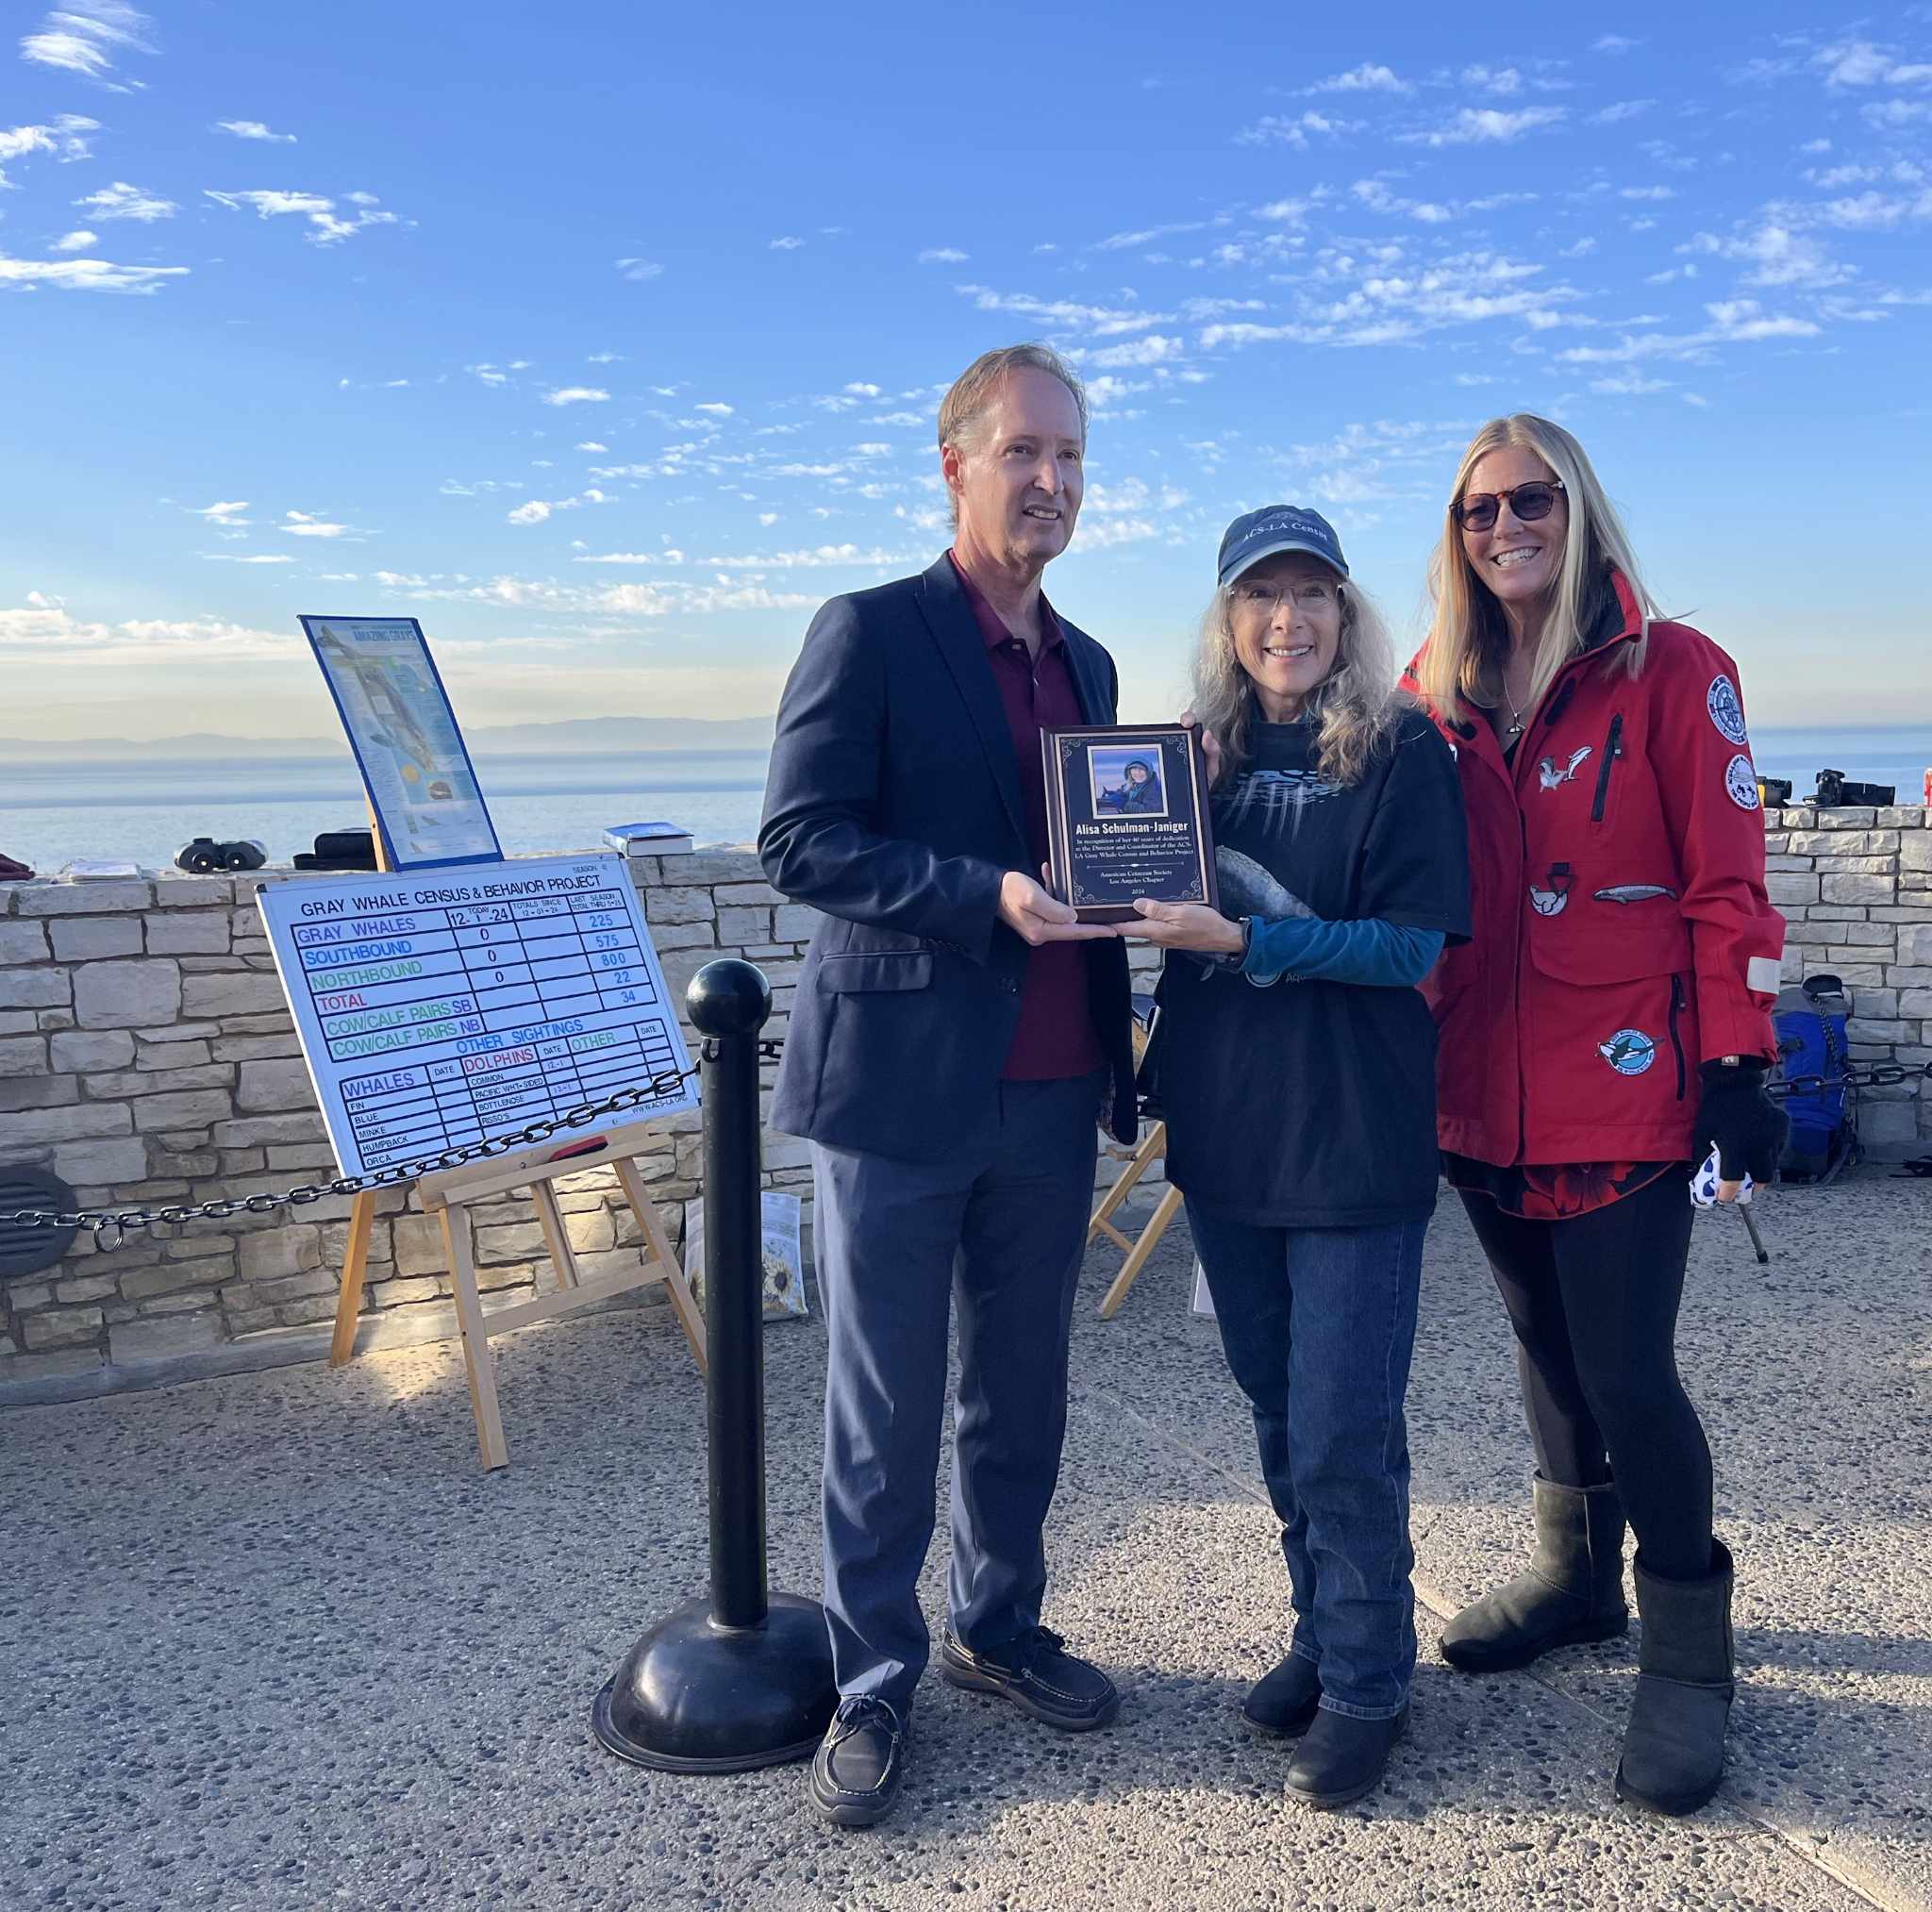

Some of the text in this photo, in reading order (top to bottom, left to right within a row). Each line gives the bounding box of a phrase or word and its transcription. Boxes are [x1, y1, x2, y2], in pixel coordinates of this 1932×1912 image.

[1241, 523, 1328, 543] ACS-LA Census
[1075, 822, 1189, 835] Alisa Schulman-Janiger
[301, 874, 601, 916] GRAY WHALE CENSUS & BEHAVIOR PROJECT
[590, 914, 614, 928] 225
[297, 918, 415, 944] GRAY WHALES
[596, 934, 619, 948] 575
[305, 940, 412, 965] SOUTHBOUND
[602, 953, 625, 967] 800
[311, 961, 423, 989] NORTHBOUND
[614, 972, 631, 983] 22
[317, 993, 367, 1011] TOTAL
[621, 990, 636, 1003] 34
[326, 1000, 472, 1036] COW/CALF PAIRS SB
[333, 1019, 480, 1056] COW/CALF PAIRS NB
[457, 1020, 584, 1054] OTHER SIGHTINGS
[572, 1025, 658, 1052] OTHER DATE
[464, 1045, 561, 1072] DOLPHINS DATE
[343, 1066, 455, 1097] WHALES DATE
[471, 1073, 504, 1086] COMMON
[475, 1086, 502, 1098] PACIFIC
[350, 1101, 365, 1110] FIN
[477, 1095, 525, 1111] BOTTLENOSE
[355, 1113, 378, 1123] BLUE
[482, 1113, 510, 1124] RISSO'S
[358, 1126, 386, 1139] MINKE
[362, 1136, 408, 1152] HUMPBACK
[366, 1155, 391, 1166] ORCA
